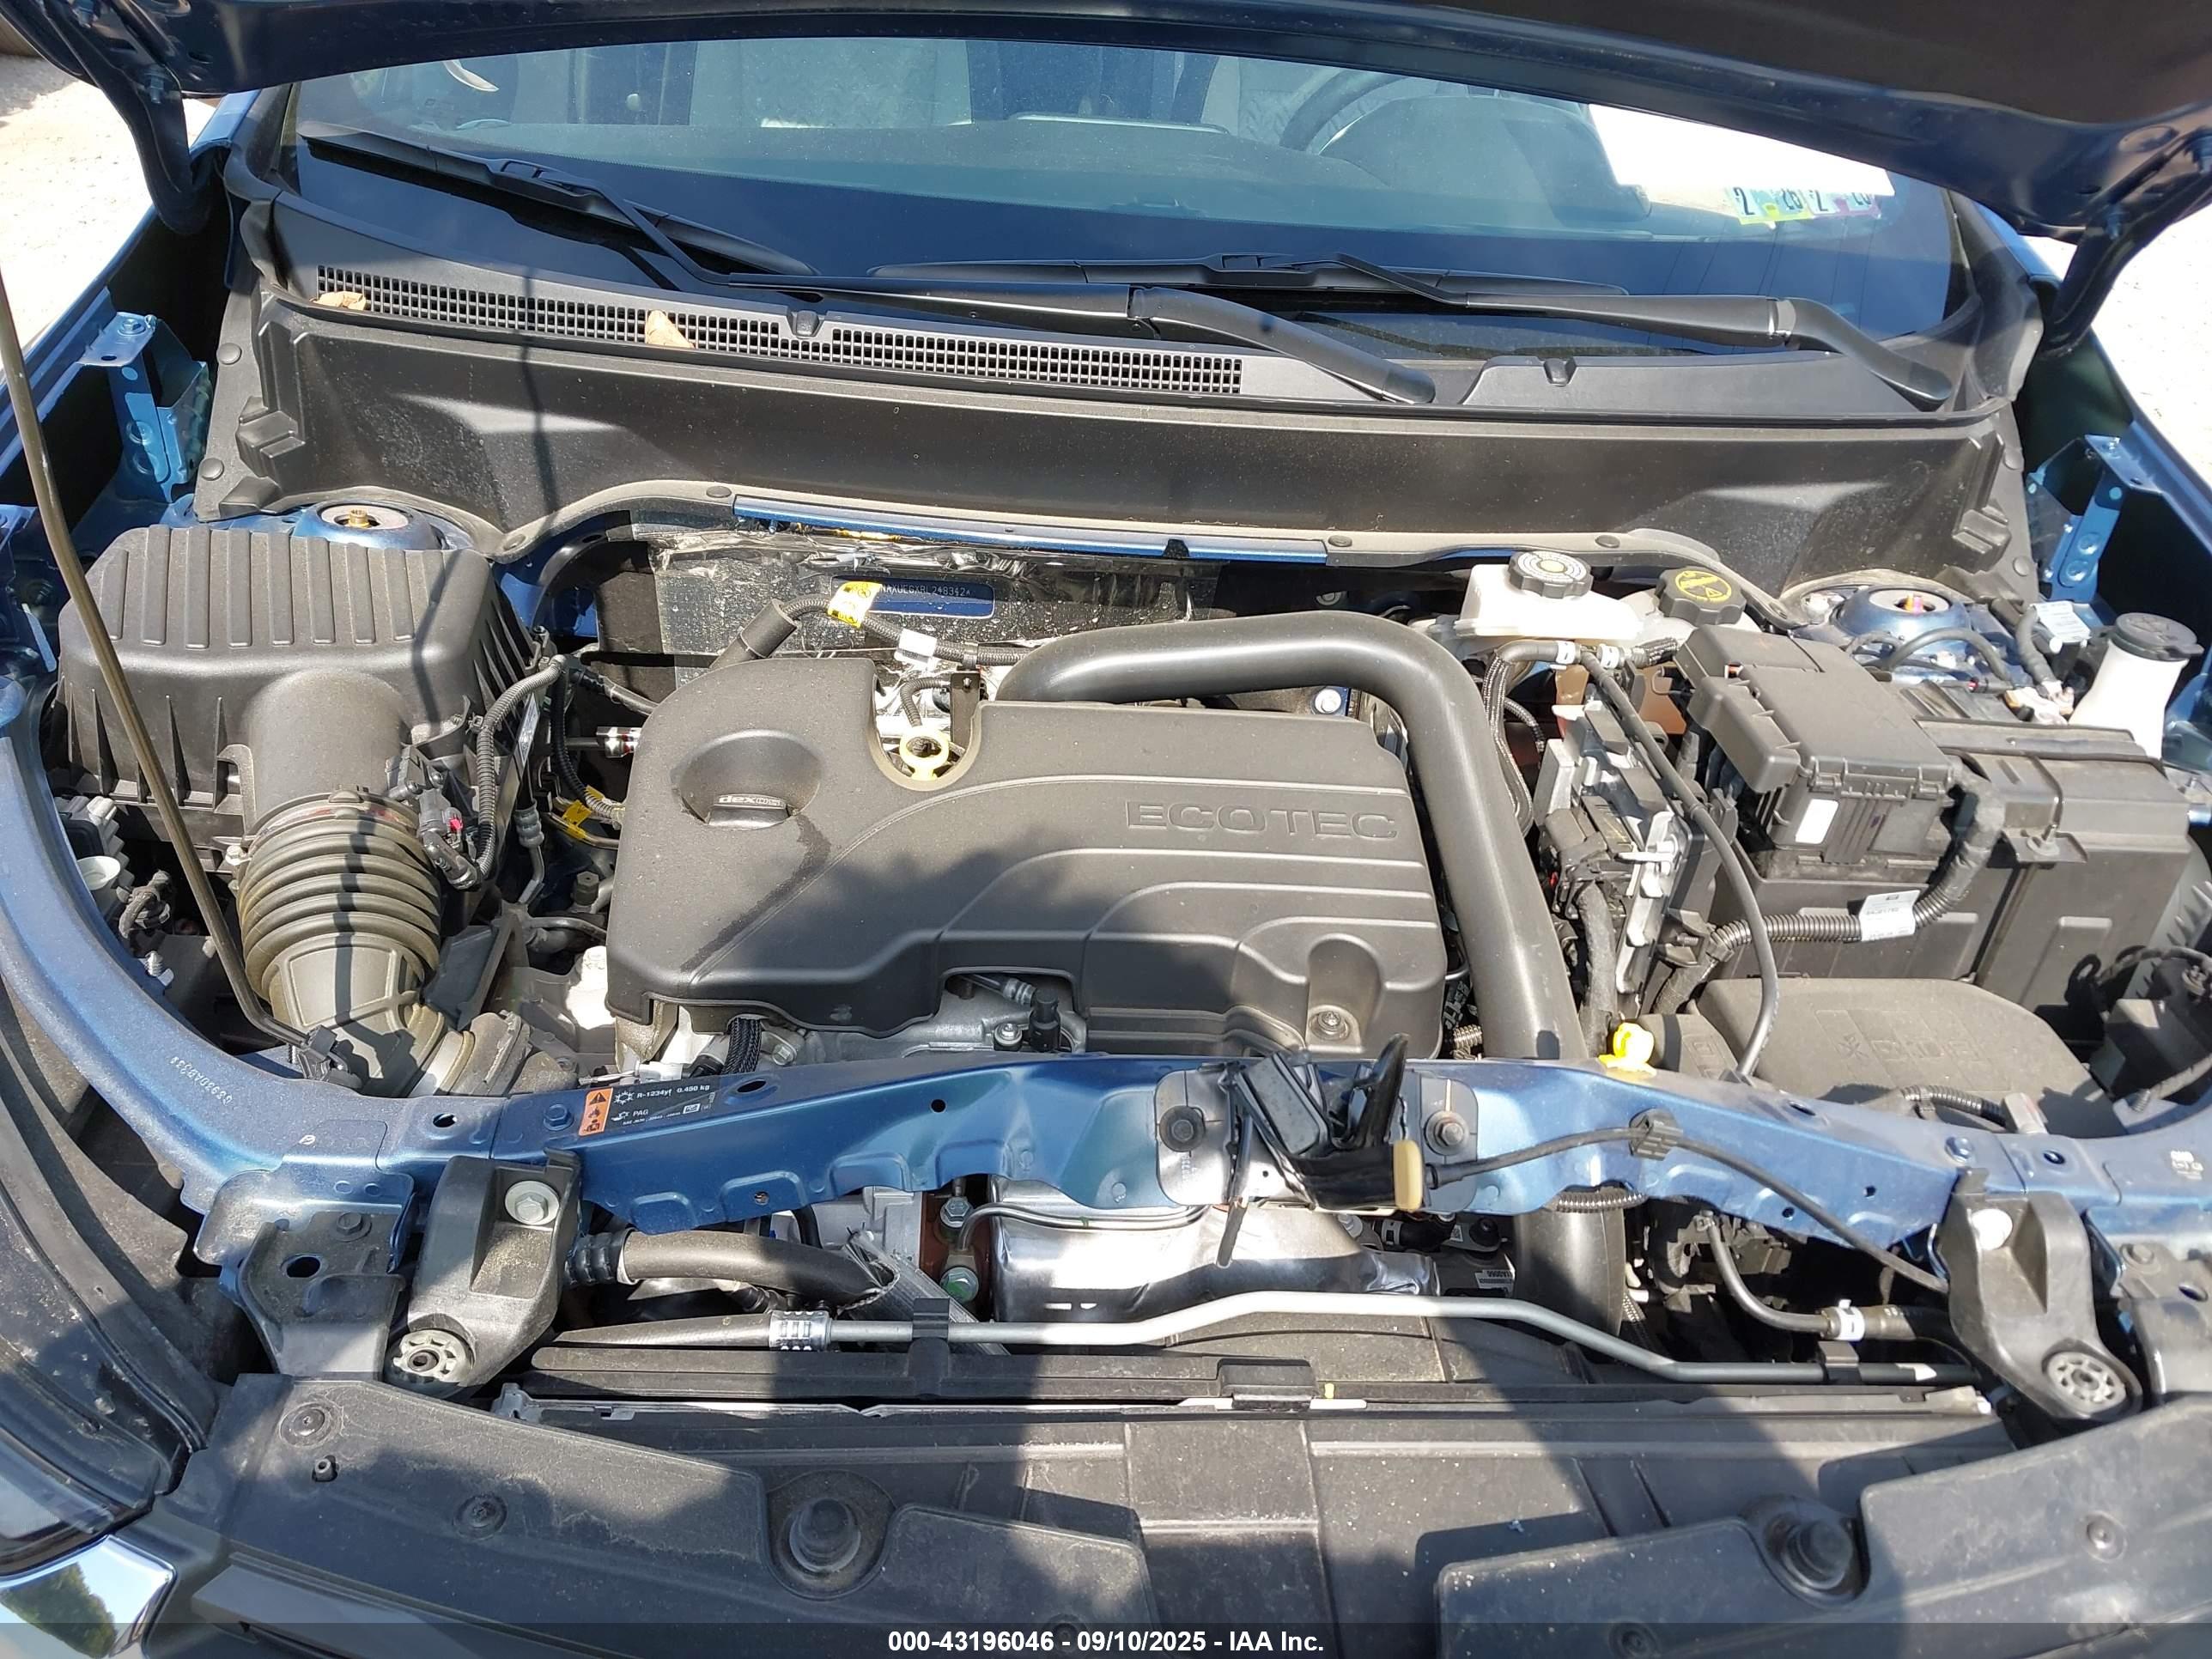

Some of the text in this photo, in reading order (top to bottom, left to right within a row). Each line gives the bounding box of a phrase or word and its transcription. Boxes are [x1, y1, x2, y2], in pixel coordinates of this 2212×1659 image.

[719, 795, 781, 806] dexos
[1126, 801, 1398, 839] ECOTEC
[636, 1089, 672, 1100] R-1234yf
[633, 1109, 649, 1117] PAG
